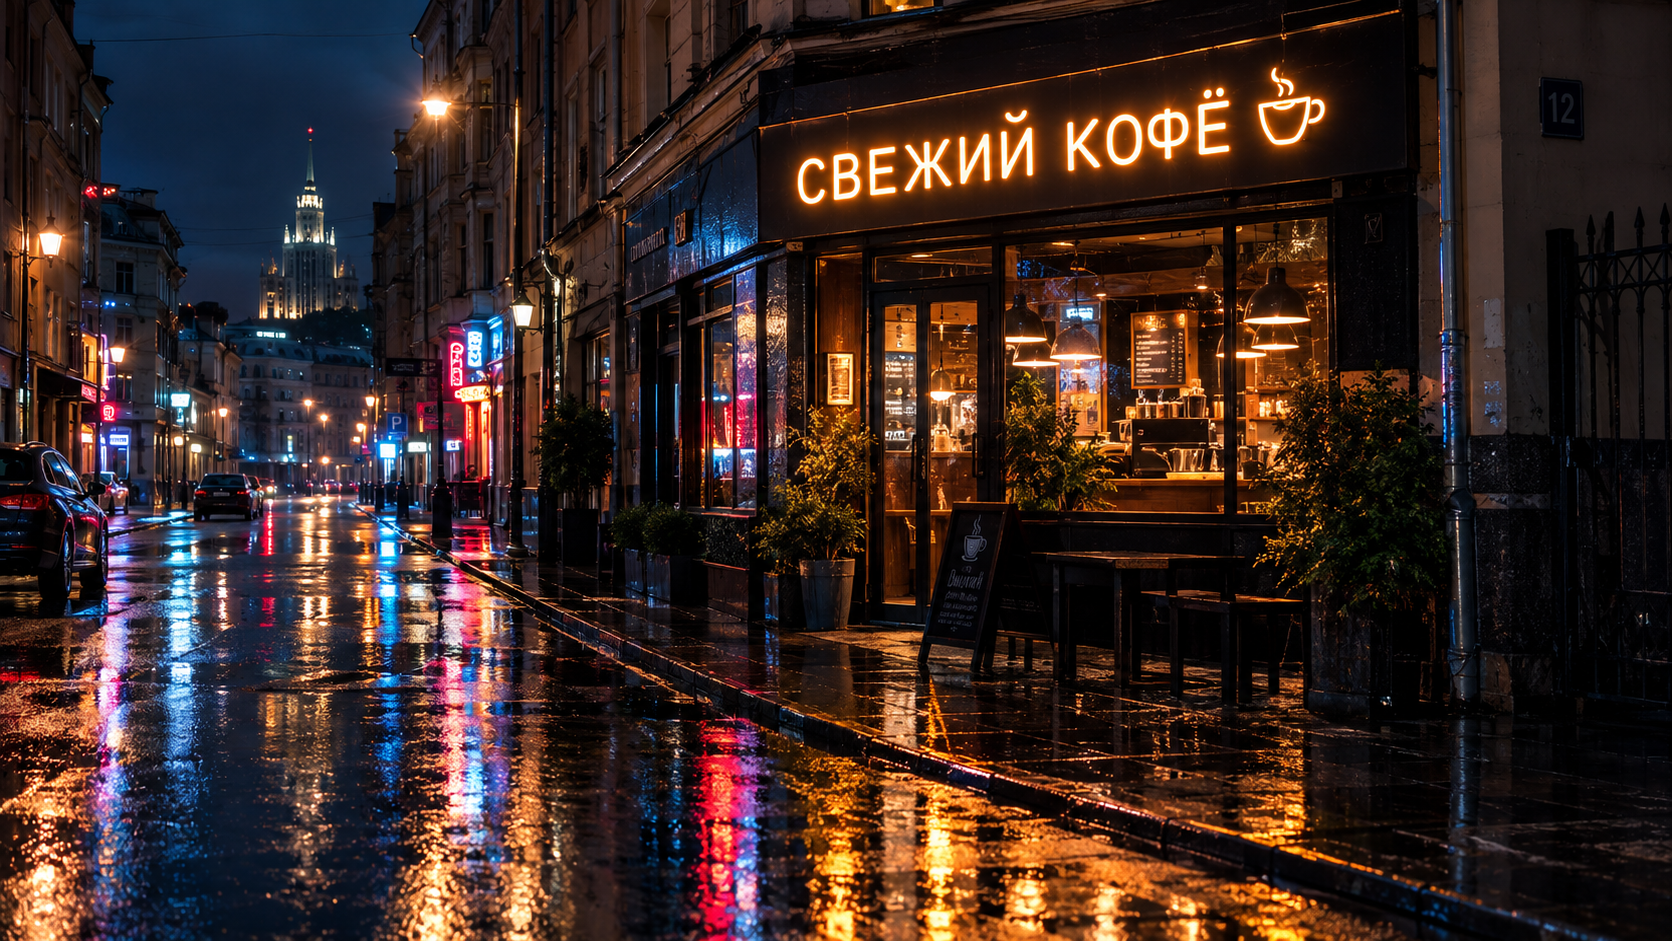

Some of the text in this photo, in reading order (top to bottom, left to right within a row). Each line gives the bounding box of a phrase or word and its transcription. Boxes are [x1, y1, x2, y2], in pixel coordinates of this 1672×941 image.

[1548, 92, 1575, 124] 12
[797, 87, 1230, 205] СВЕЖИЙ КОФЁ
[391, 416, 402, 430] P
